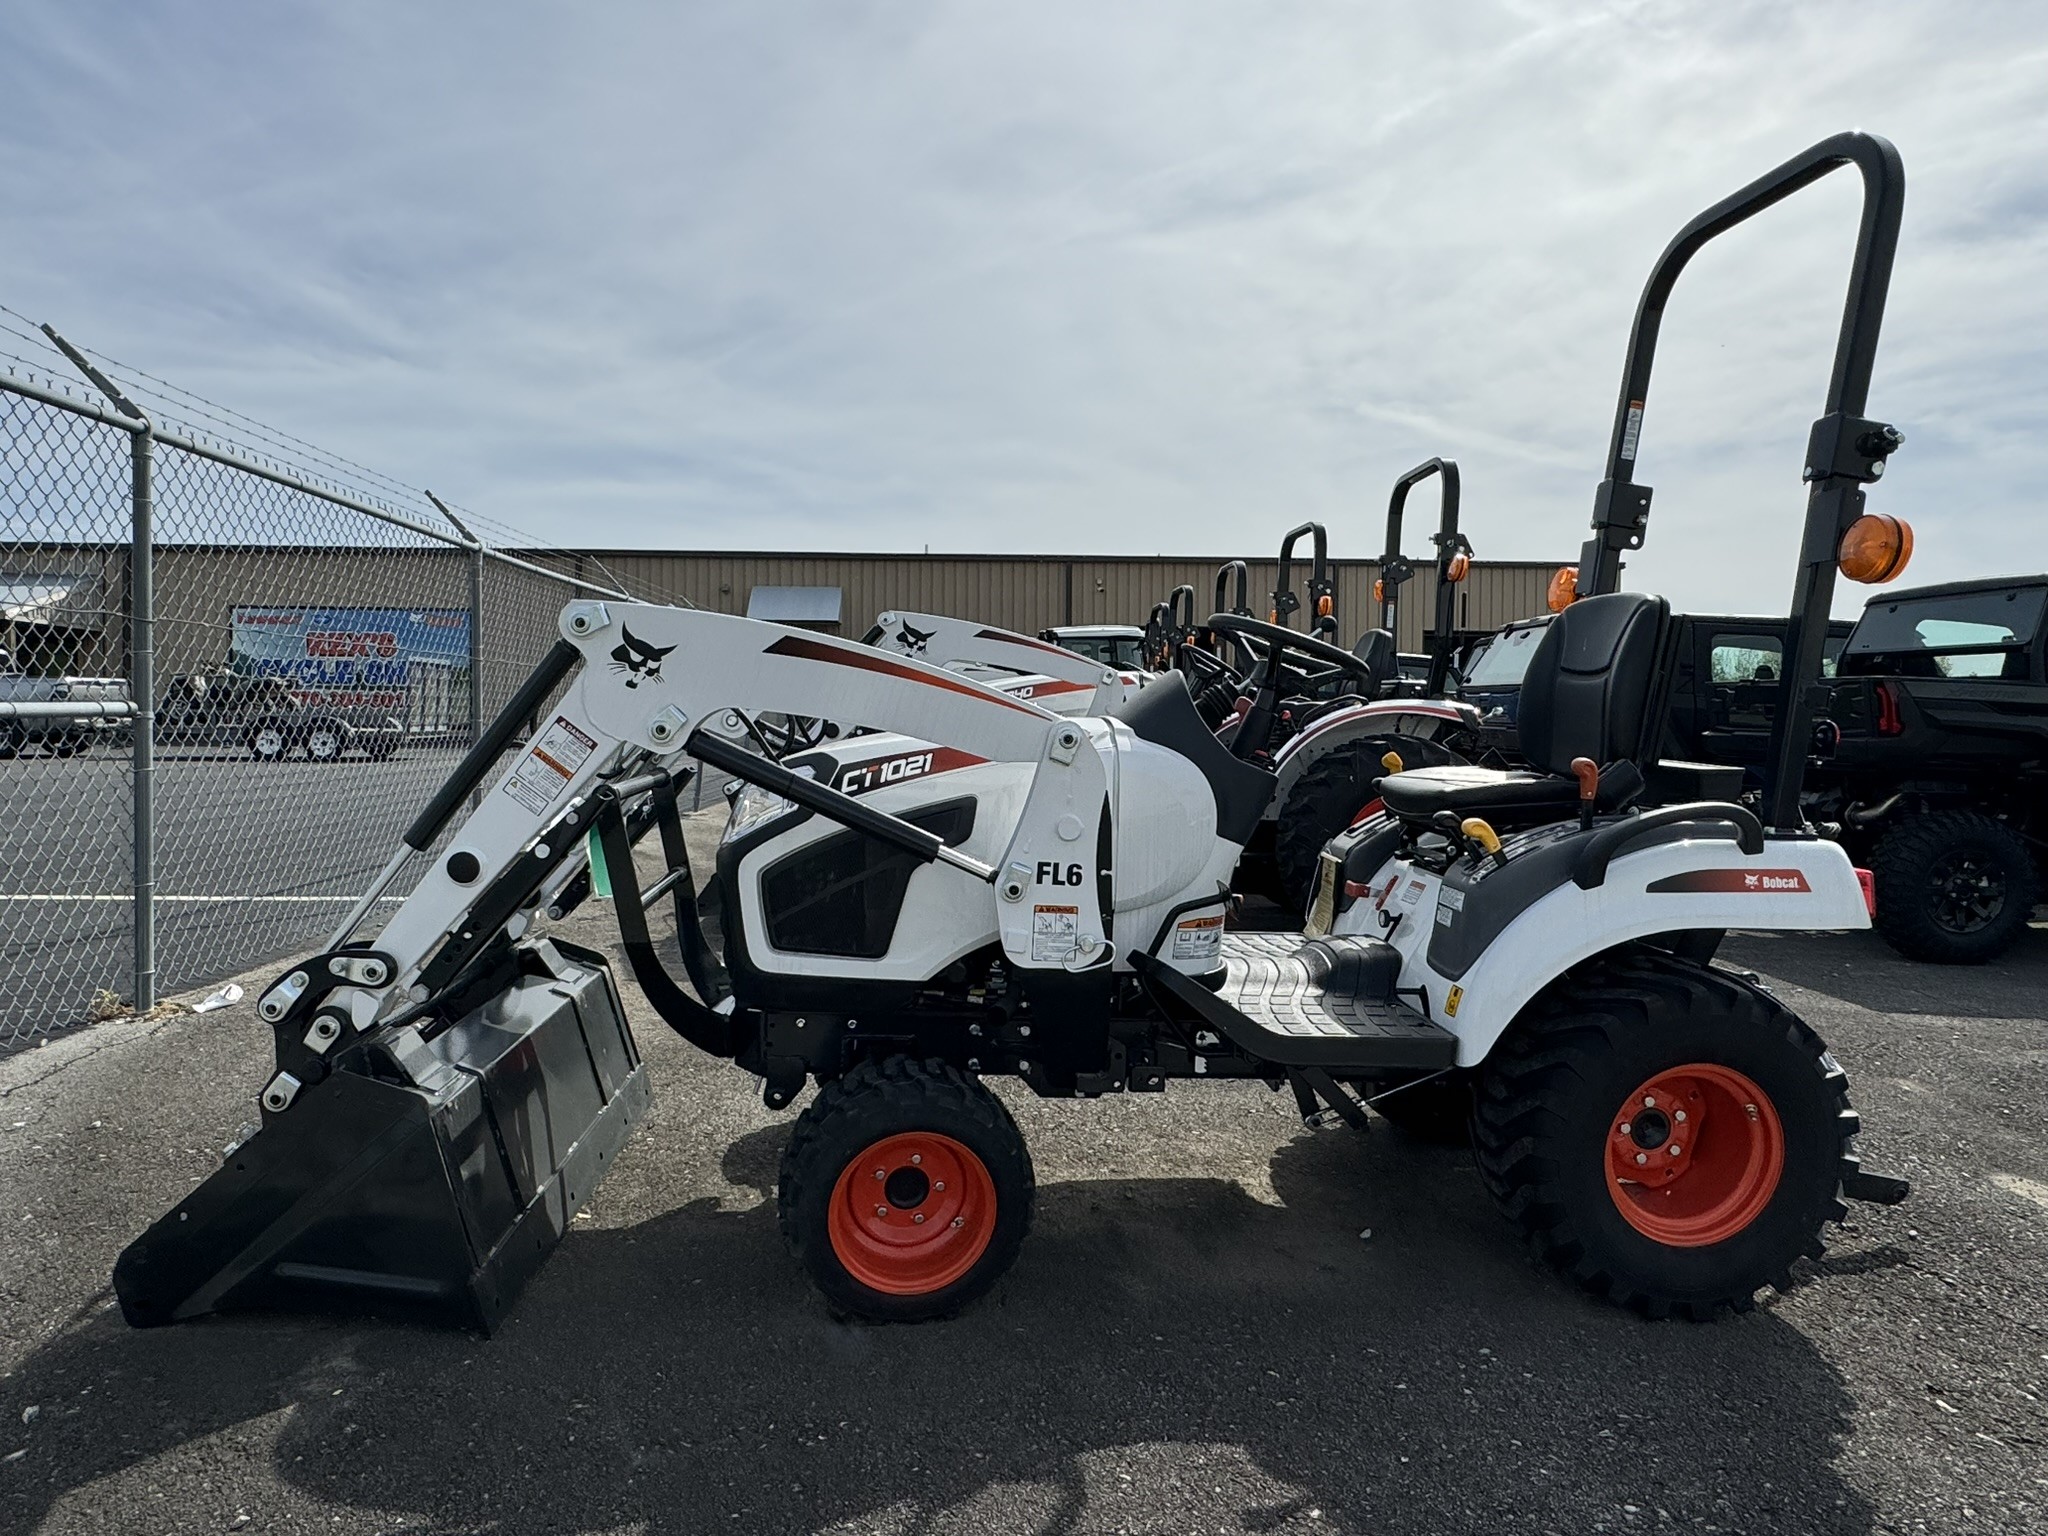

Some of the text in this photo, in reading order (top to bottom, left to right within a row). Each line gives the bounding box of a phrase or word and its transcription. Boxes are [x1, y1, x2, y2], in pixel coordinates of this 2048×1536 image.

[306, 632, 398, 658] REX'S
[565, 724, 594, 747] DANGER
[541, 753, 569, 778] WARNING
[841, 752, 934, 793] CT1021
[1036, 861, 1083, 887] FL6
[1762, 876, 1799, 889] Bobcat
